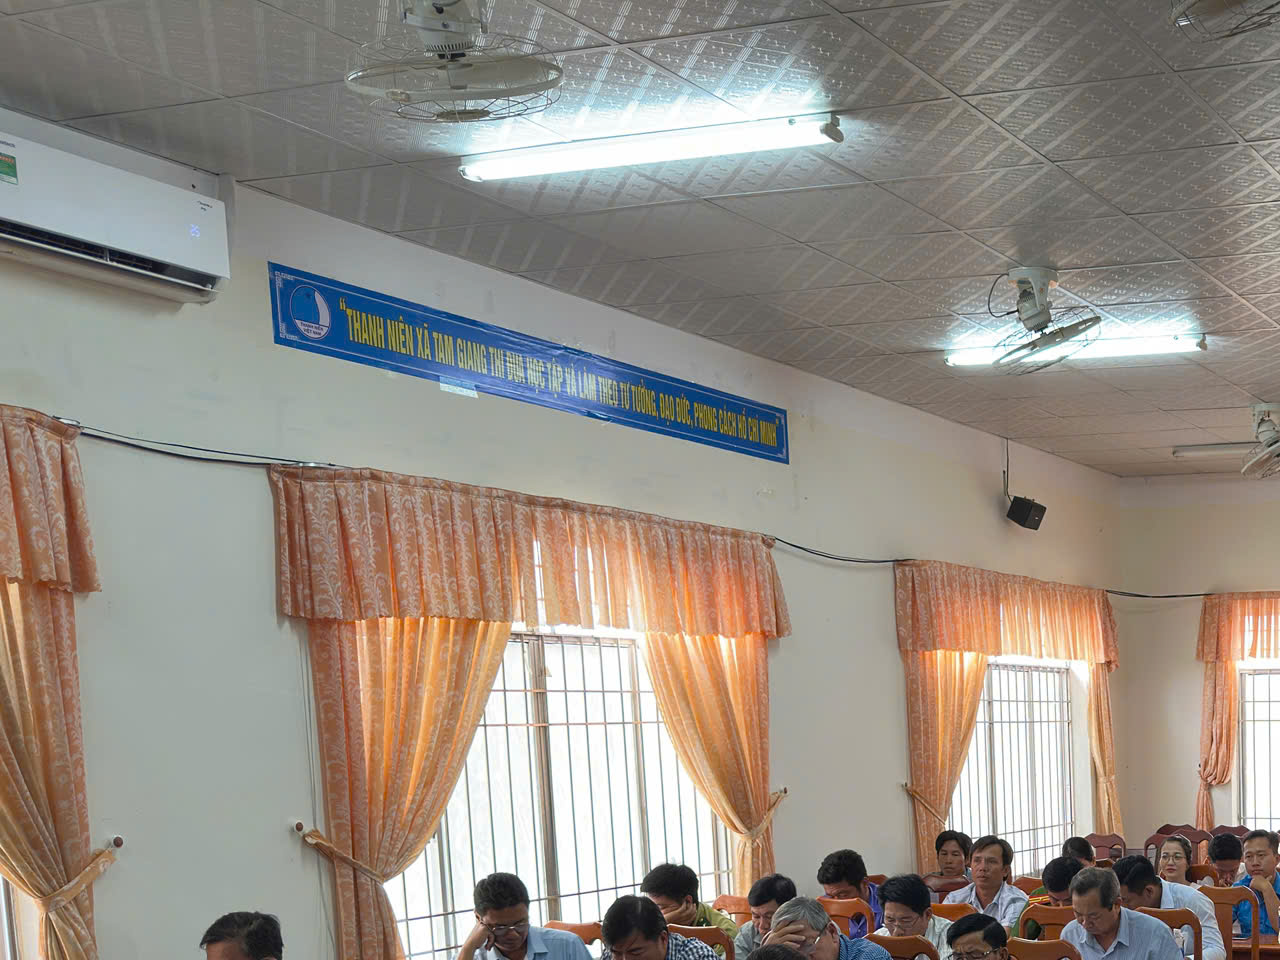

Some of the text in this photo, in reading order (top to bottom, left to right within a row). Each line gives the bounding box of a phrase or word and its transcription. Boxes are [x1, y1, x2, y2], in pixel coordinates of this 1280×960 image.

[388, 315, 414, 356] NIÊN
[416, 323, 432, 360] XÃ
[432, 331, 455, 366] TAM
[456, 339, 488, 375] GIANG
[489, 347, 505, 378] THI
[526, 356, 545, 393] HỌC
[547, 357, 563, 398] TẬP
[564, 364, 577, 397] VÀ
[578, 367, 596, 401] LÀM
[598, 376, 618, 408] THEO
[659, 392, 675, 426] ĐẠO
[693, 402, 718, 432] PHONG
[719, 405, 737, 437] CÁCH
[738, 407, 747, 439] HỒ
[748, 414, 759, 442] CHÍ
